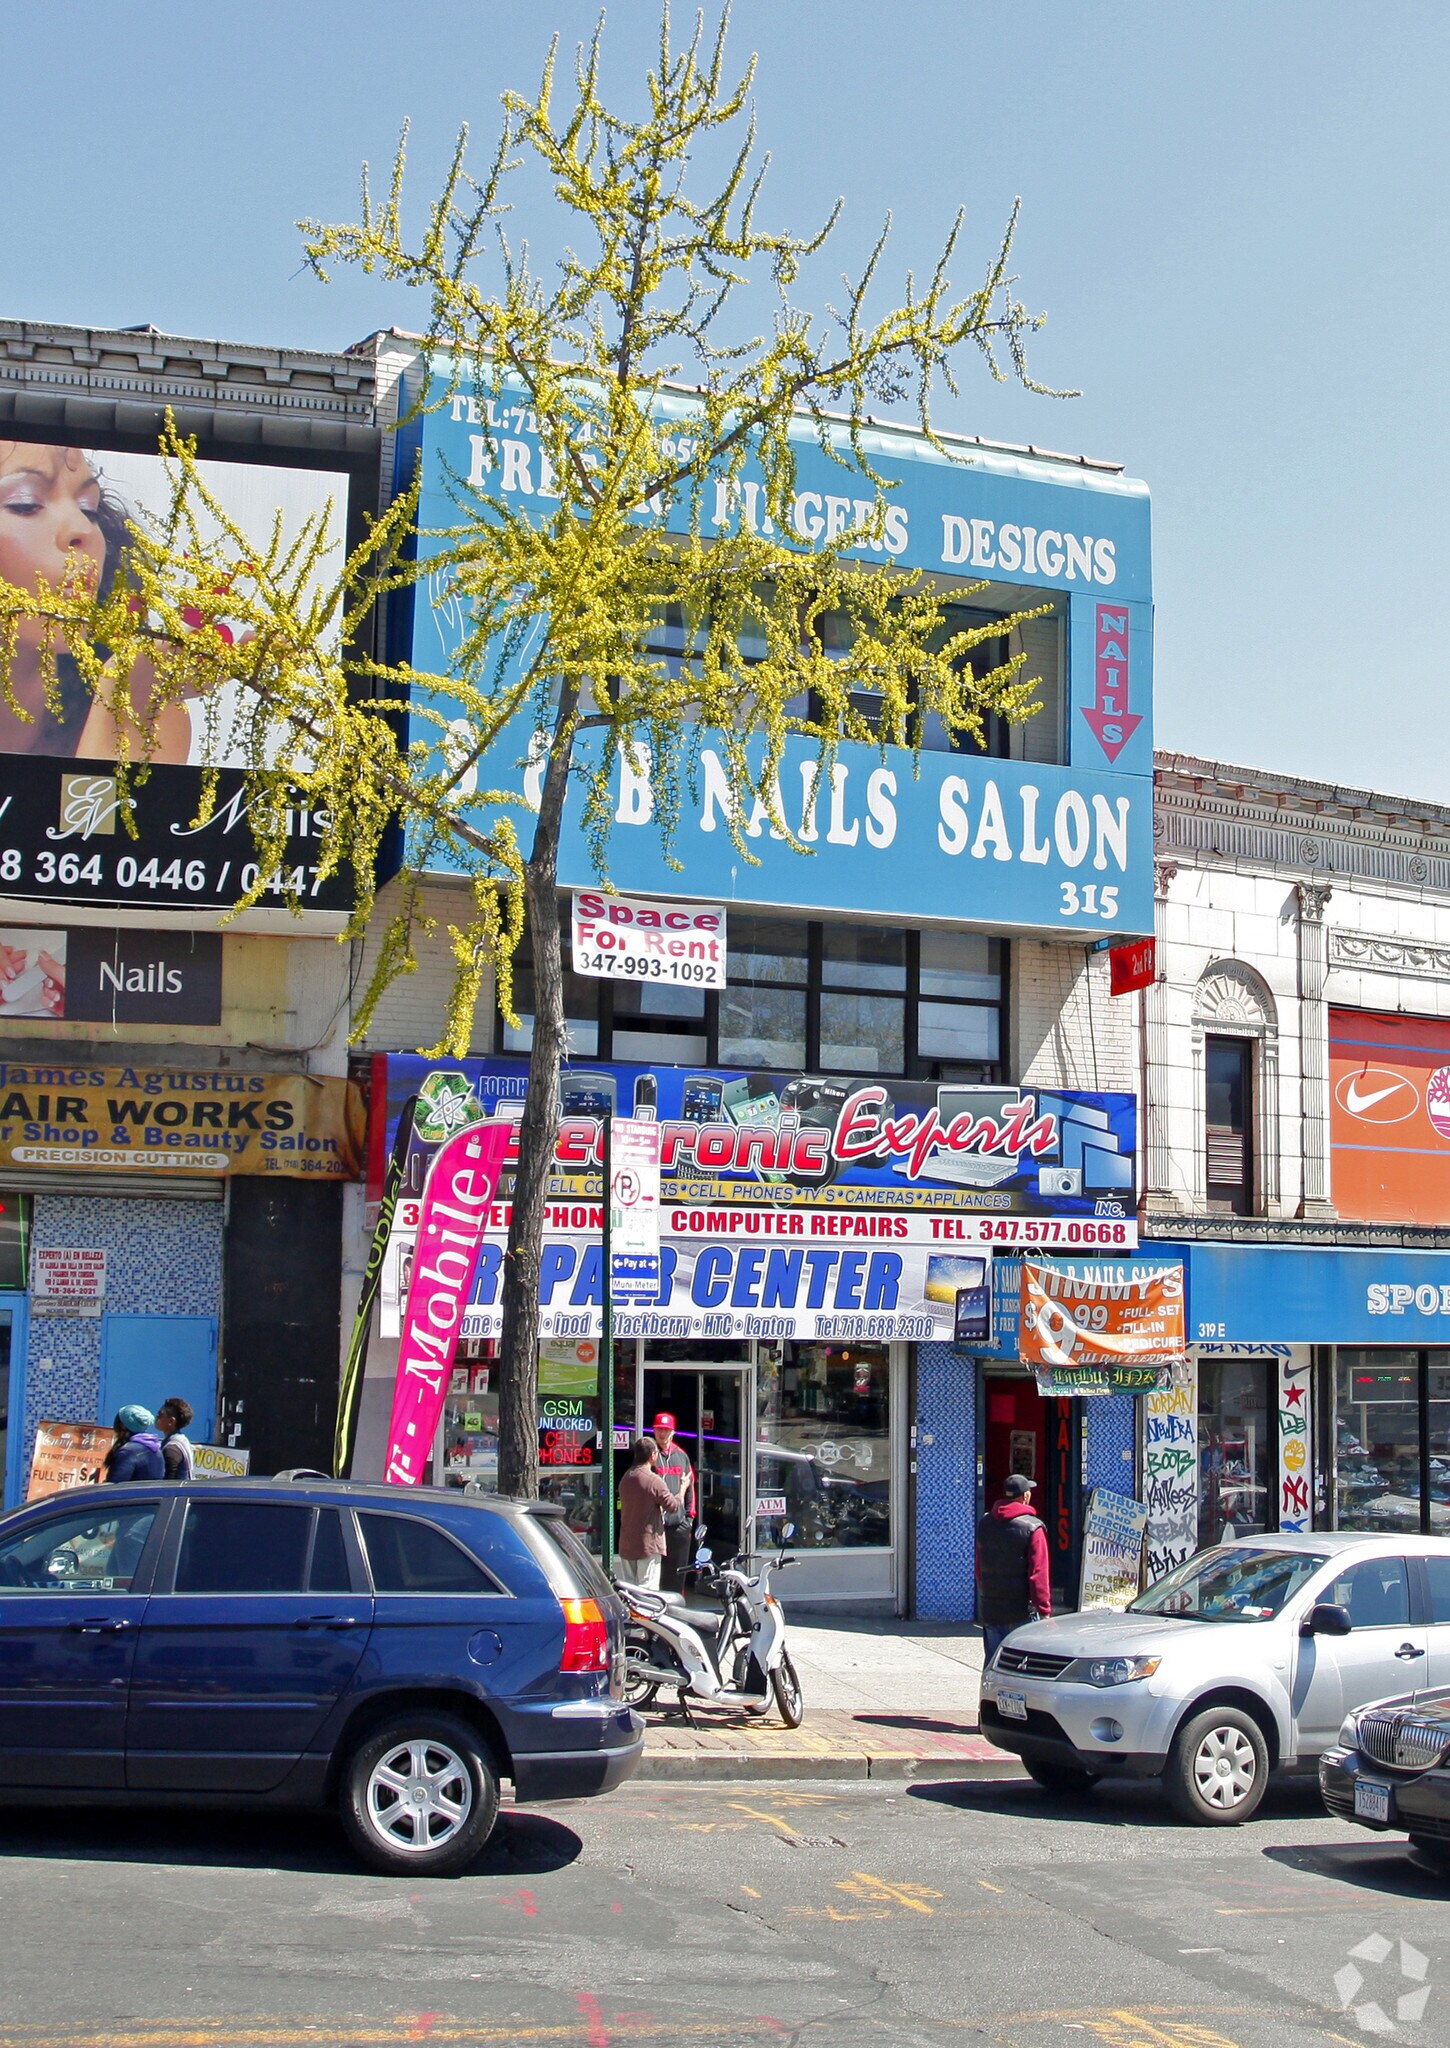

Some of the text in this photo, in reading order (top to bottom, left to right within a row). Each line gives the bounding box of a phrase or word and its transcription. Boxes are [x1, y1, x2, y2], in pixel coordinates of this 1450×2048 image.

[941, 514, 1116, 584] DESIGNS
[1100, 613, 1128, 745] NAILS
[700, 749, 897, 849] NAILS
[937, 775, 1130, 872] SALON
[34, 851, 103, 885] 364
[116, 856, 206, 892] 0446
[240, 863, 327, 896] 0447
[1059, 881, 1119, 919] 315
[577, 894, 720, 932] Space
[644, 931, 720, 962] Rent
[580, 951, 717, 983] 347-993-1092
[99, 961, 183, 993] Nails
[0, 1064, 265, 1095] James Agustus
[824, 1087, 846, 1098] Nikon
[106, 1099, 294, 1130] WORKS
[23, 1122, 99, 1148] Shop
[110, 1125, 132, 1145] &
[144, 1126, 250, 1152] Beauty
[260, 1131, 338, 1152] Salon
[833, 1086, 1060, 1180] Experts
[23, 1149, 218, 1166] PRECISION CUTTING
[301, 1159, 350, 1173] 364-202
[545, 1179, 577, 1193] ELL
[688, 1182, 722, 1199] CELL
[732, 1184, 793, 1200] PHONES
[801, 1188, 835, 1202] TV'S
[845, 1190, 914, 1205] CAMERAS
[923, 1193, 1011, 1208] APPLIANCES
[1094, 1200, 1126, 1217] INC.
[671, 1210, 803, 1235] COMPUTER
[811, 1214, 908, 1238] REPAIRS
[930, 1218, 972, 1240] TEL.
[979, 1221, 1126, 1245] 347.577.0668
[623, 1257, 648, 1270] Pay at
[690, 1246, 902, 1310] CENTER
[1157, 1304, 1181, 1317] SET
[553, 1312, 590, 1337] ipod
[704, 1316, 732, 1338] HTC
[745, 1315, 796, 1339] Laptop
[815, 1315, 934, 1339] Tel.718.688.2308
[1122, 1323, 1165, 1335] FILL-IN
[1198, 1323, 1226, 1338] 319 E
[1077, 1352, 1099, 1363] ALL
[543, 1400, 584, 1417] GSM
[537, 1418, 593, 1432] UNLOCKED
[545, 1431, 580, 1448] CELL
[33, 1469, 54, 1481] FULL
[57, 1472, 75, 1483] SET
[758, 1499, 783, 1510] ATM
[1097, 1490, 1147, 1515] BUBU'S
[1097, 1500, 1138, 1519] TATTOO
[1091, 1514, 1142, 1538] PIERCINGS
[1105, 1512, 1132, 1525] AND
[1088, 1541, 1138, 1561] JIMMY'S
[1085, 1583, 1101, 1591] EYE
